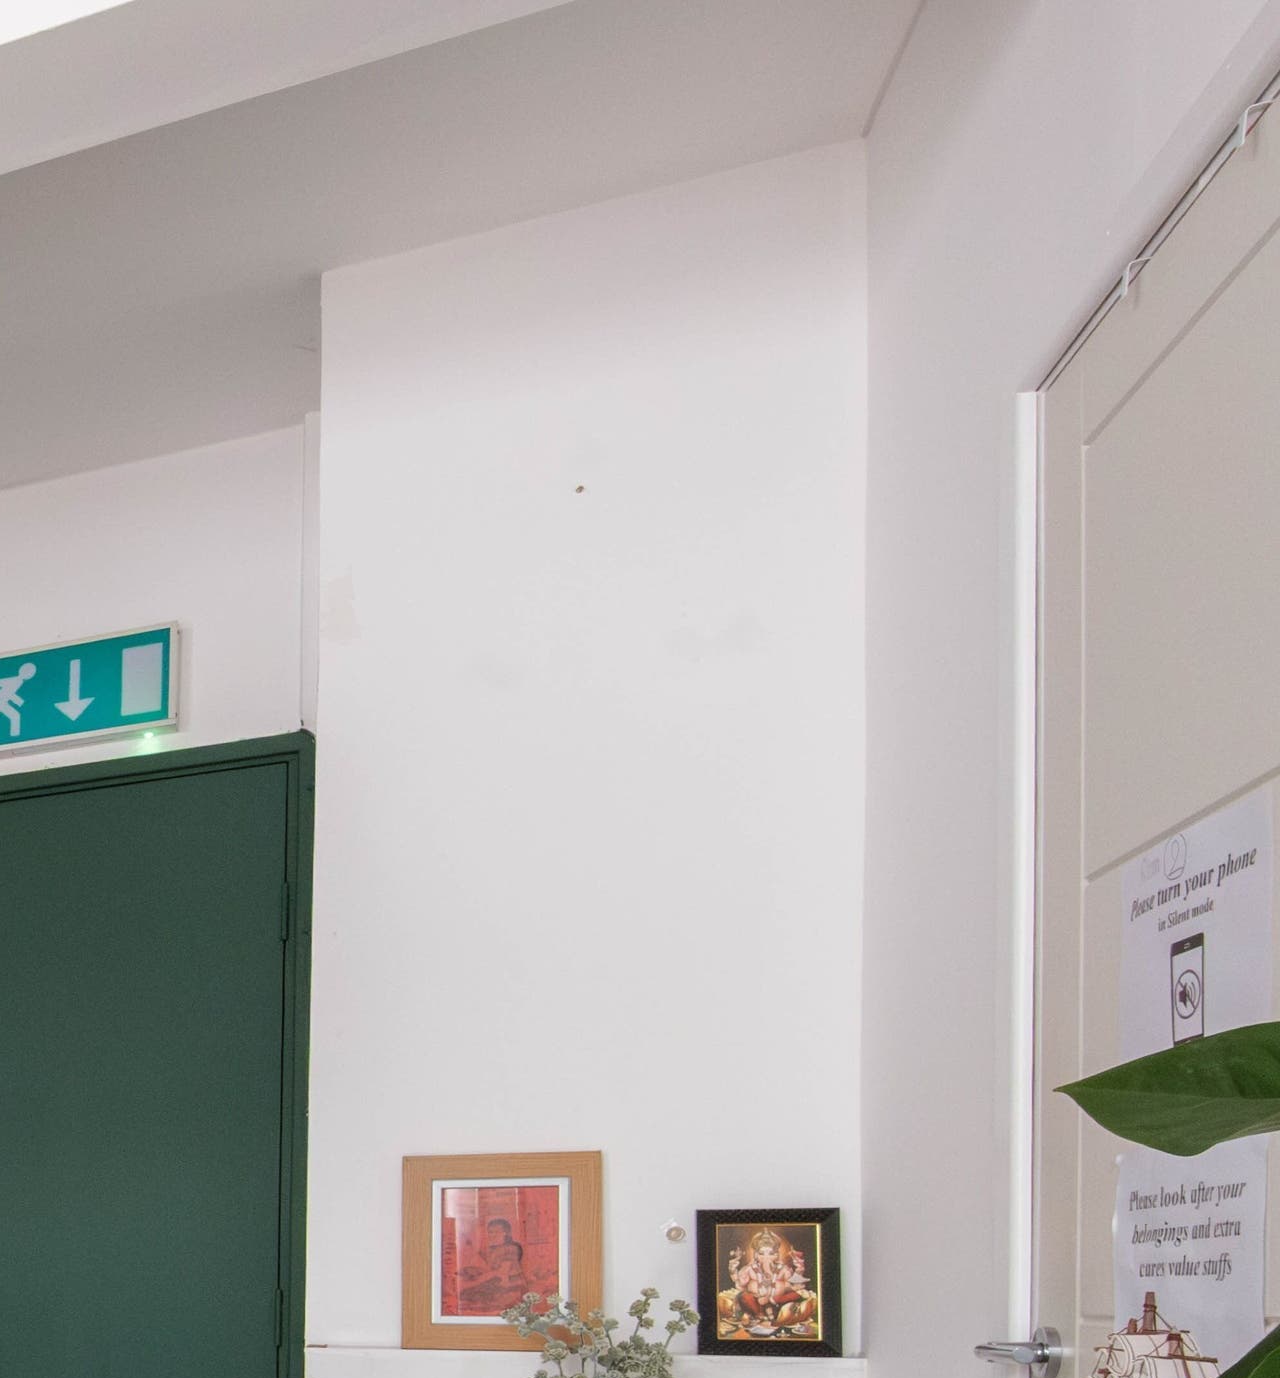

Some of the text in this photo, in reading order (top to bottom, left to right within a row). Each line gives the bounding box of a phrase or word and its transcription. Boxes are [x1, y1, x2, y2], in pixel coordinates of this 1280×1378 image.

[1130, 895, 1155, 921] Please
[1157, 882, 1181, 906] turn
[1183, 868, 1214, 901] your
[1216, 848, 1257, 887] phone
[1158, 897, 1214, 932] in Silent mode
[1129, 1181, 1247, 1211] Please look after your
[1131, 1216, 1241, 1248] belongings and extra
[1139, 1252, 1232, 1281] cares value stuffs
